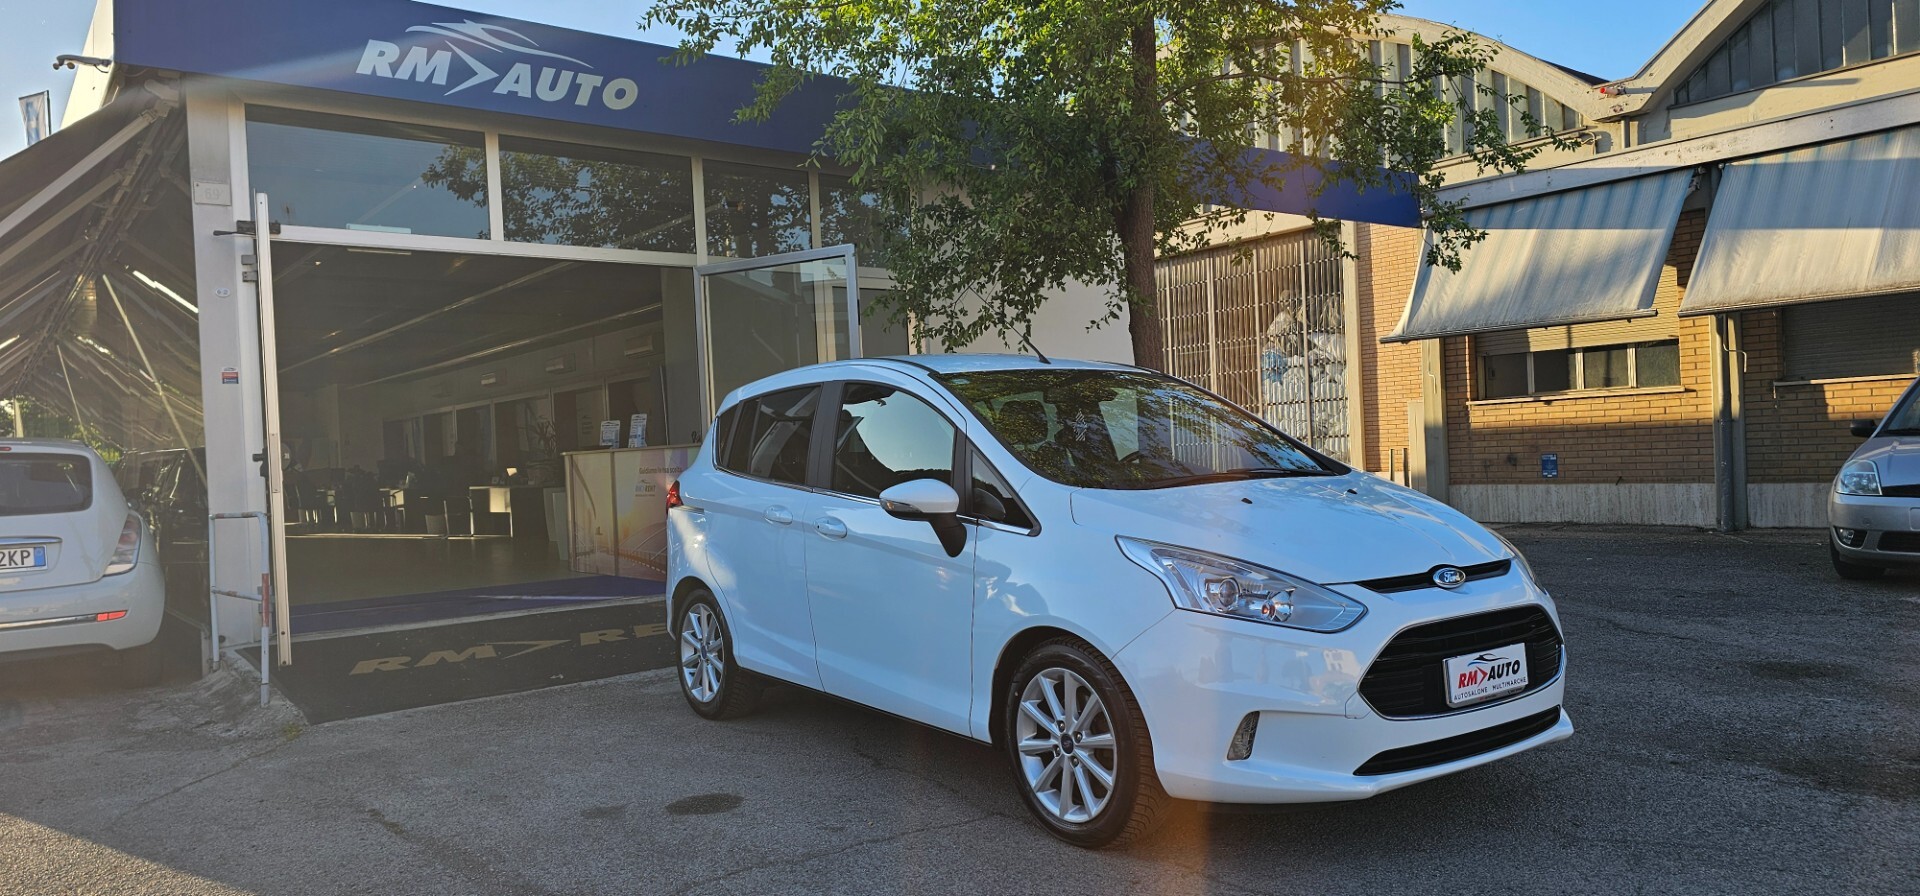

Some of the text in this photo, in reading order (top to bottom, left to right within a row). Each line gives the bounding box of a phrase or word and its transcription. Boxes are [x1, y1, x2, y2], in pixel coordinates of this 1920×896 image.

[492, 62, 639, 110] AUTO
[1444, 571, 1461, 582] Ford
[1458, 660, 1521, 689] RM AUTO
[1454, 687, 1488, 701] AUTOSALONE
[1492, 677, 1527, 691] MULTIMARCHE
